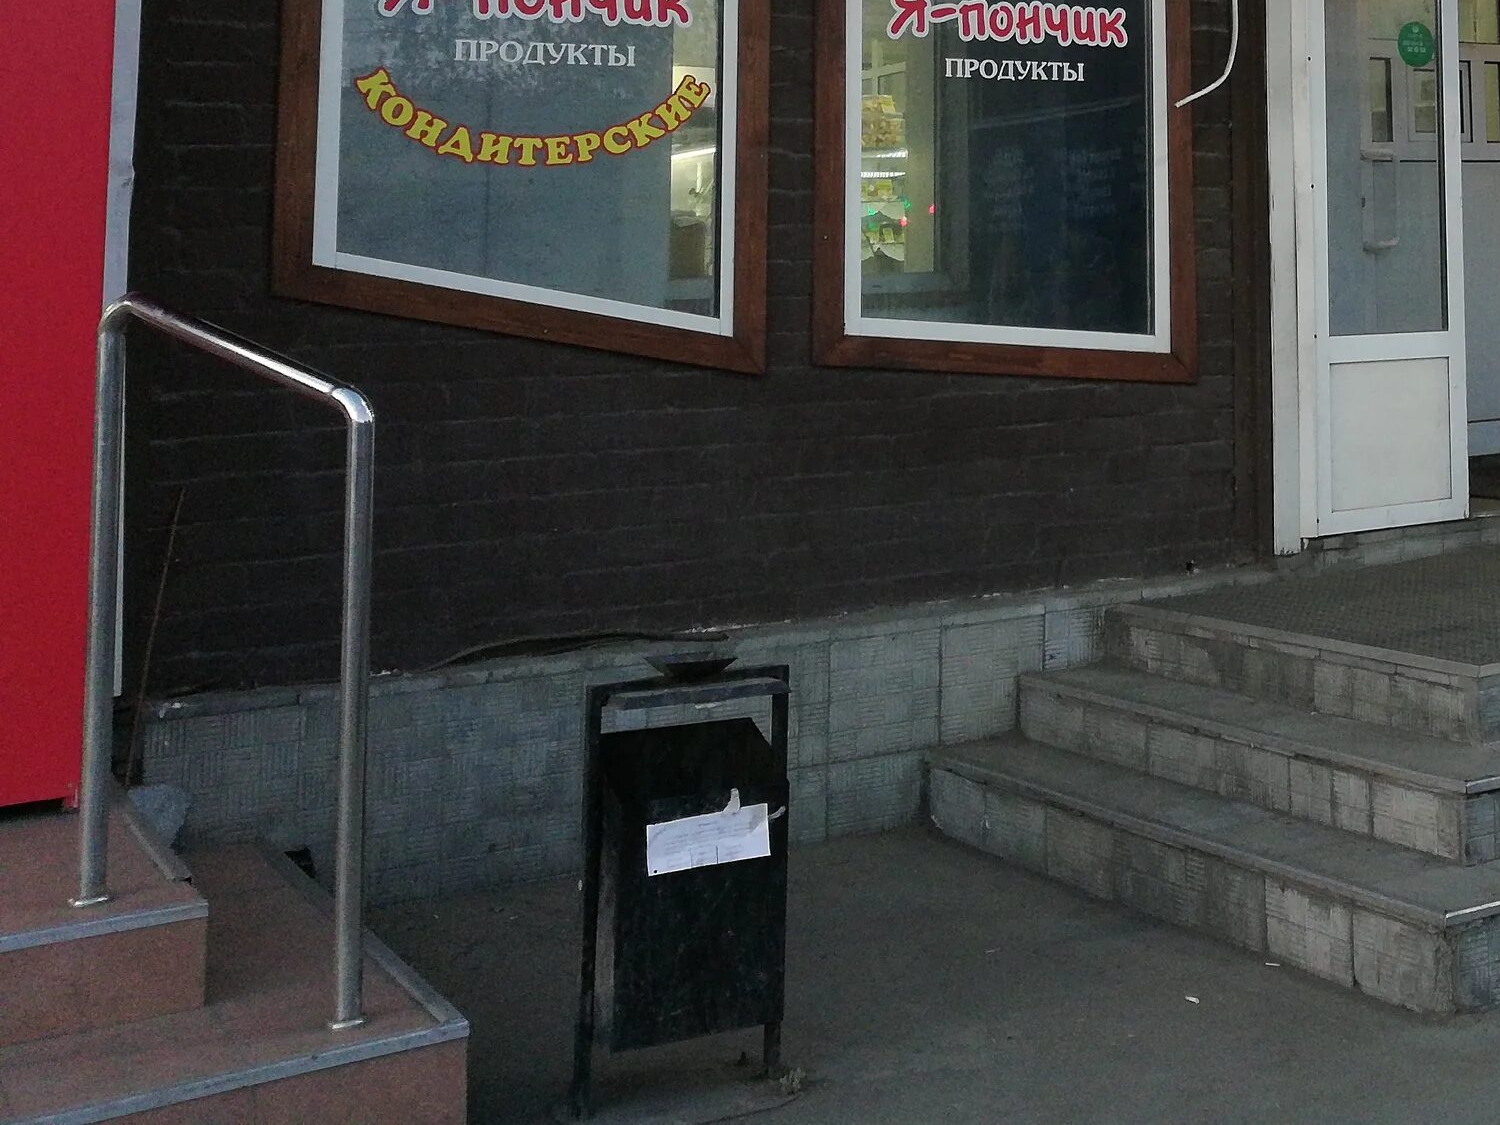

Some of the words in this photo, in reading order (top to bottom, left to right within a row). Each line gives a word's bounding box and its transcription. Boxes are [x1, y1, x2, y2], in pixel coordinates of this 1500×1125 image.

[454, 39, 636, 68] ПРОДУКТЫ
[944, 57, 1085, 82] ПРОДУКТЫ
[354, 67, 712, 166] КОНДИТЕРСКИЕ
